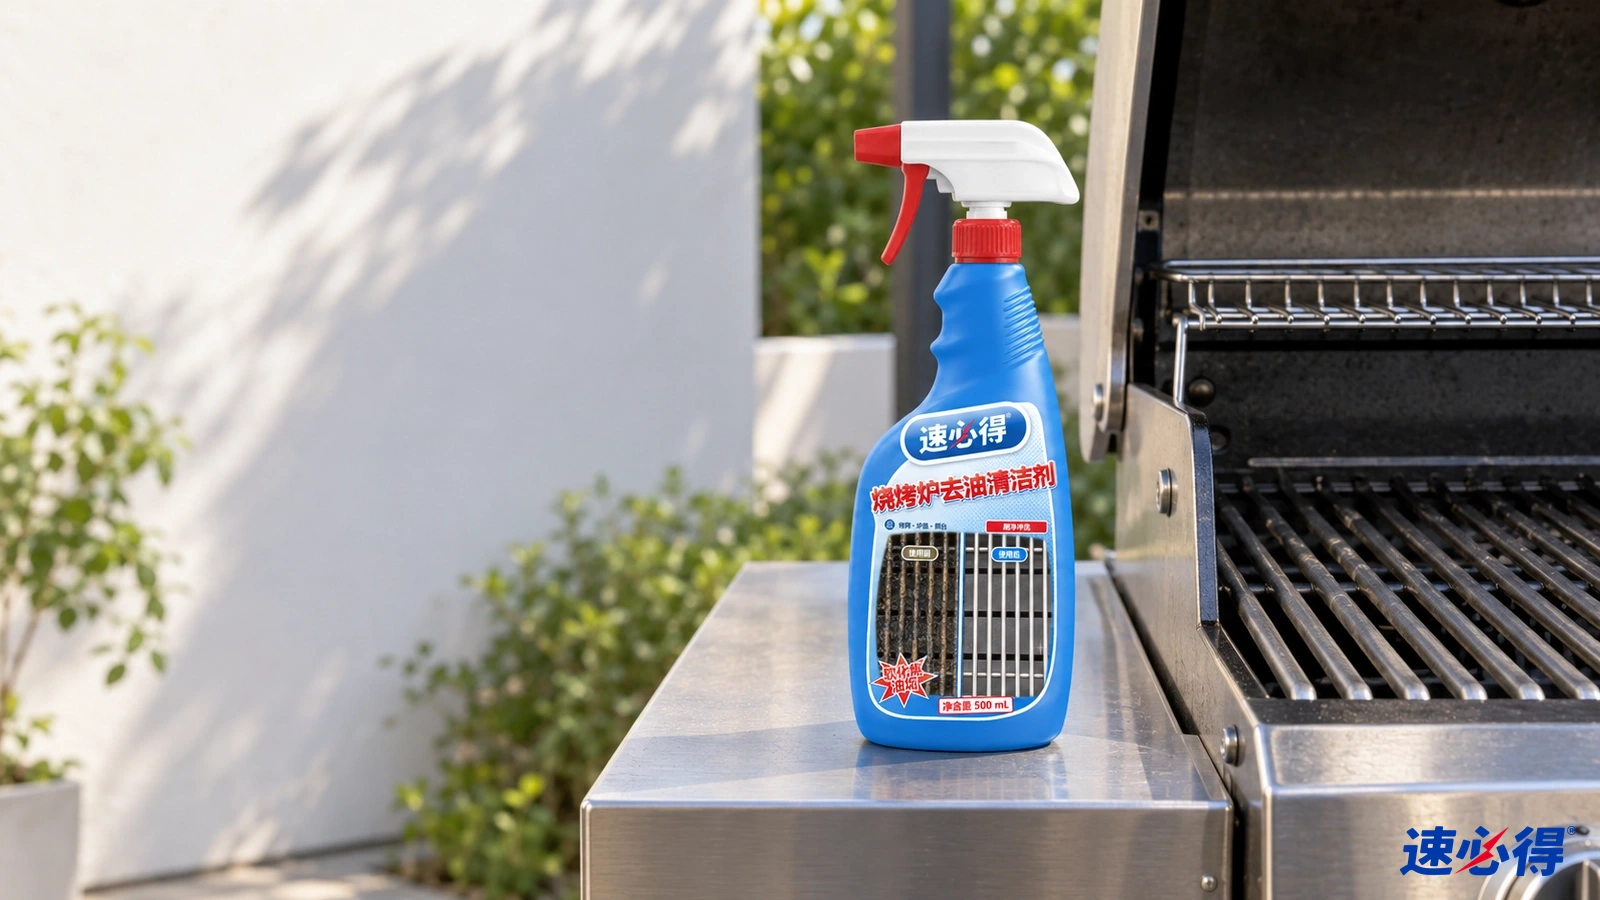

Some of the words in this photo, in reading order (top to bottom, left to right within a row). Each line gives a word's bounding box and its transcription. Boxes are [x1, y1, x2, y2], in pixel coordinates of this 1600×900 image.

[919, 414, 1007, 454] 速必得
[871, 460, 1057, 513] 烧烤炉去油清洁剂
[974, 700, 992, 710] 500
[994, 700, 1009, 709] mL
